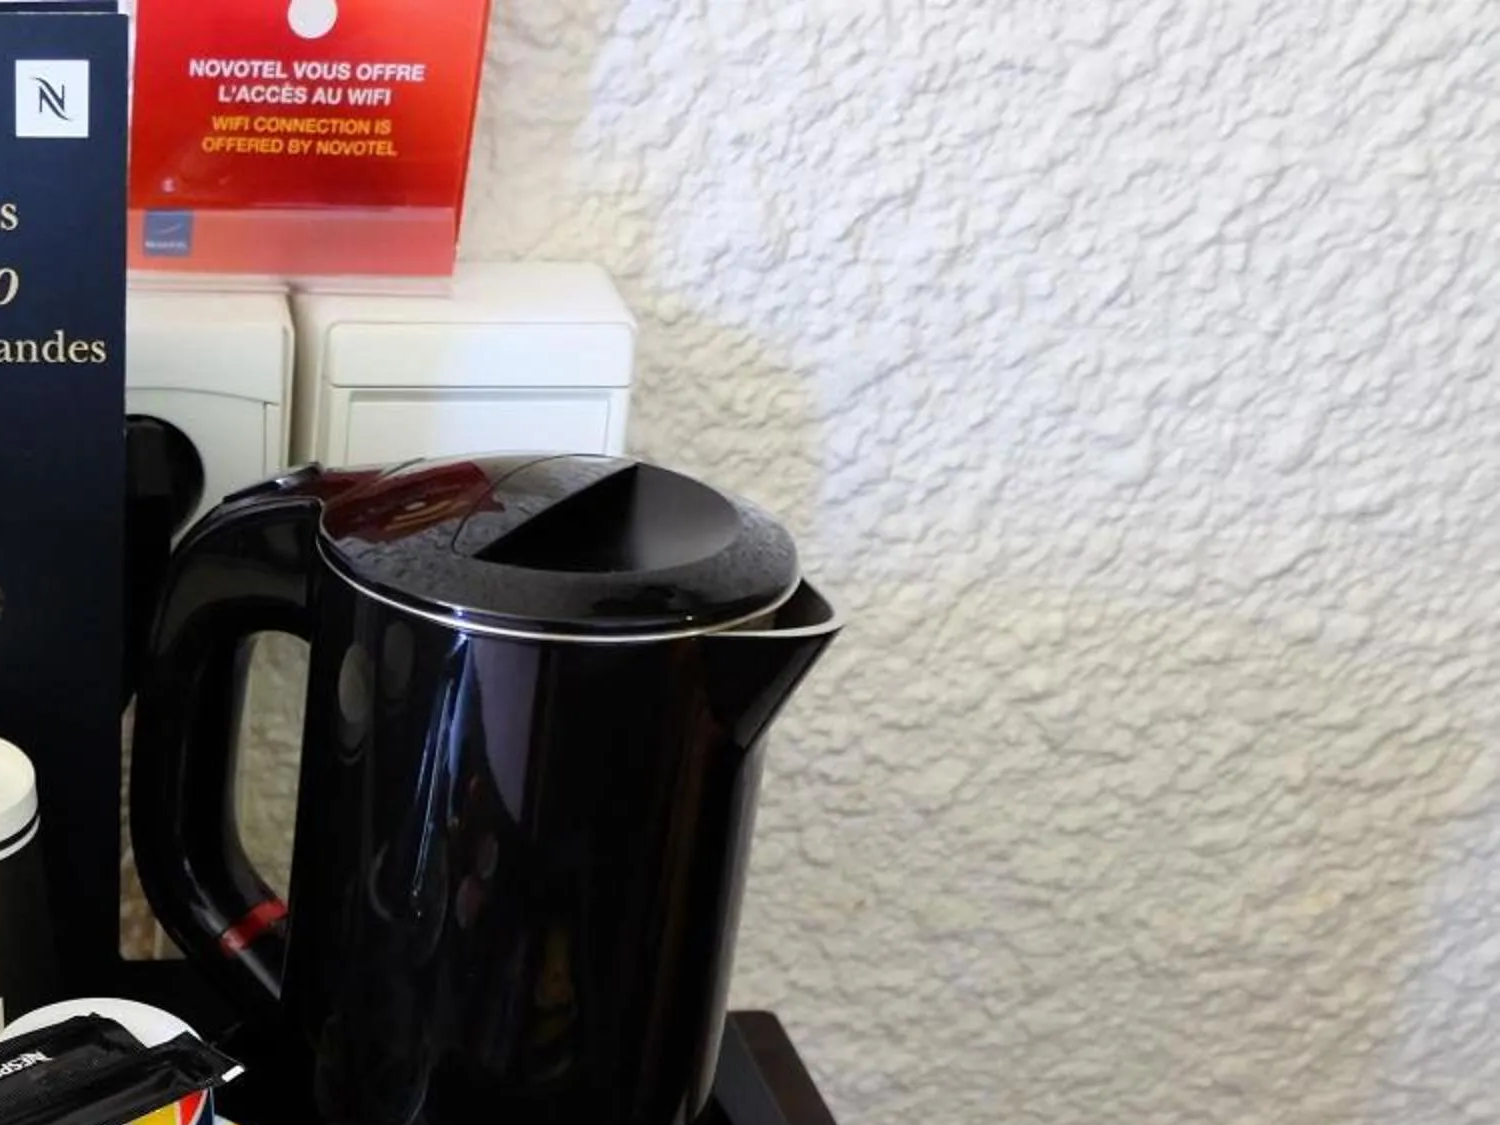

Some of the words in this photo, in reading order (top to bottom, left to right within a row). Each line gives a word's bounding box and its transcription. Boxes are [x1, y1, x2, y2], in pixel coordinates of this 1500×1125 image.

[189, 59, 287, 79] NOVOTEL
[293, 62, 351, 80] VOUS
[356, 63, 425, 82] OFFRE
[218, 83, 308, 104] L'ACCÈS
[312, 87, 343, 105] AU
[348, 89, 392, 106] WIFI
[212, 115, 251, 132] WIFI
[254, 116, 371, 135] CONNECTION
[375, 119, 392, 135] IS
[202, 138, 283, 155] OFFERED
[288, 139, 314, 155] BY
[316, 141, 396, 156] NOVOTEL
